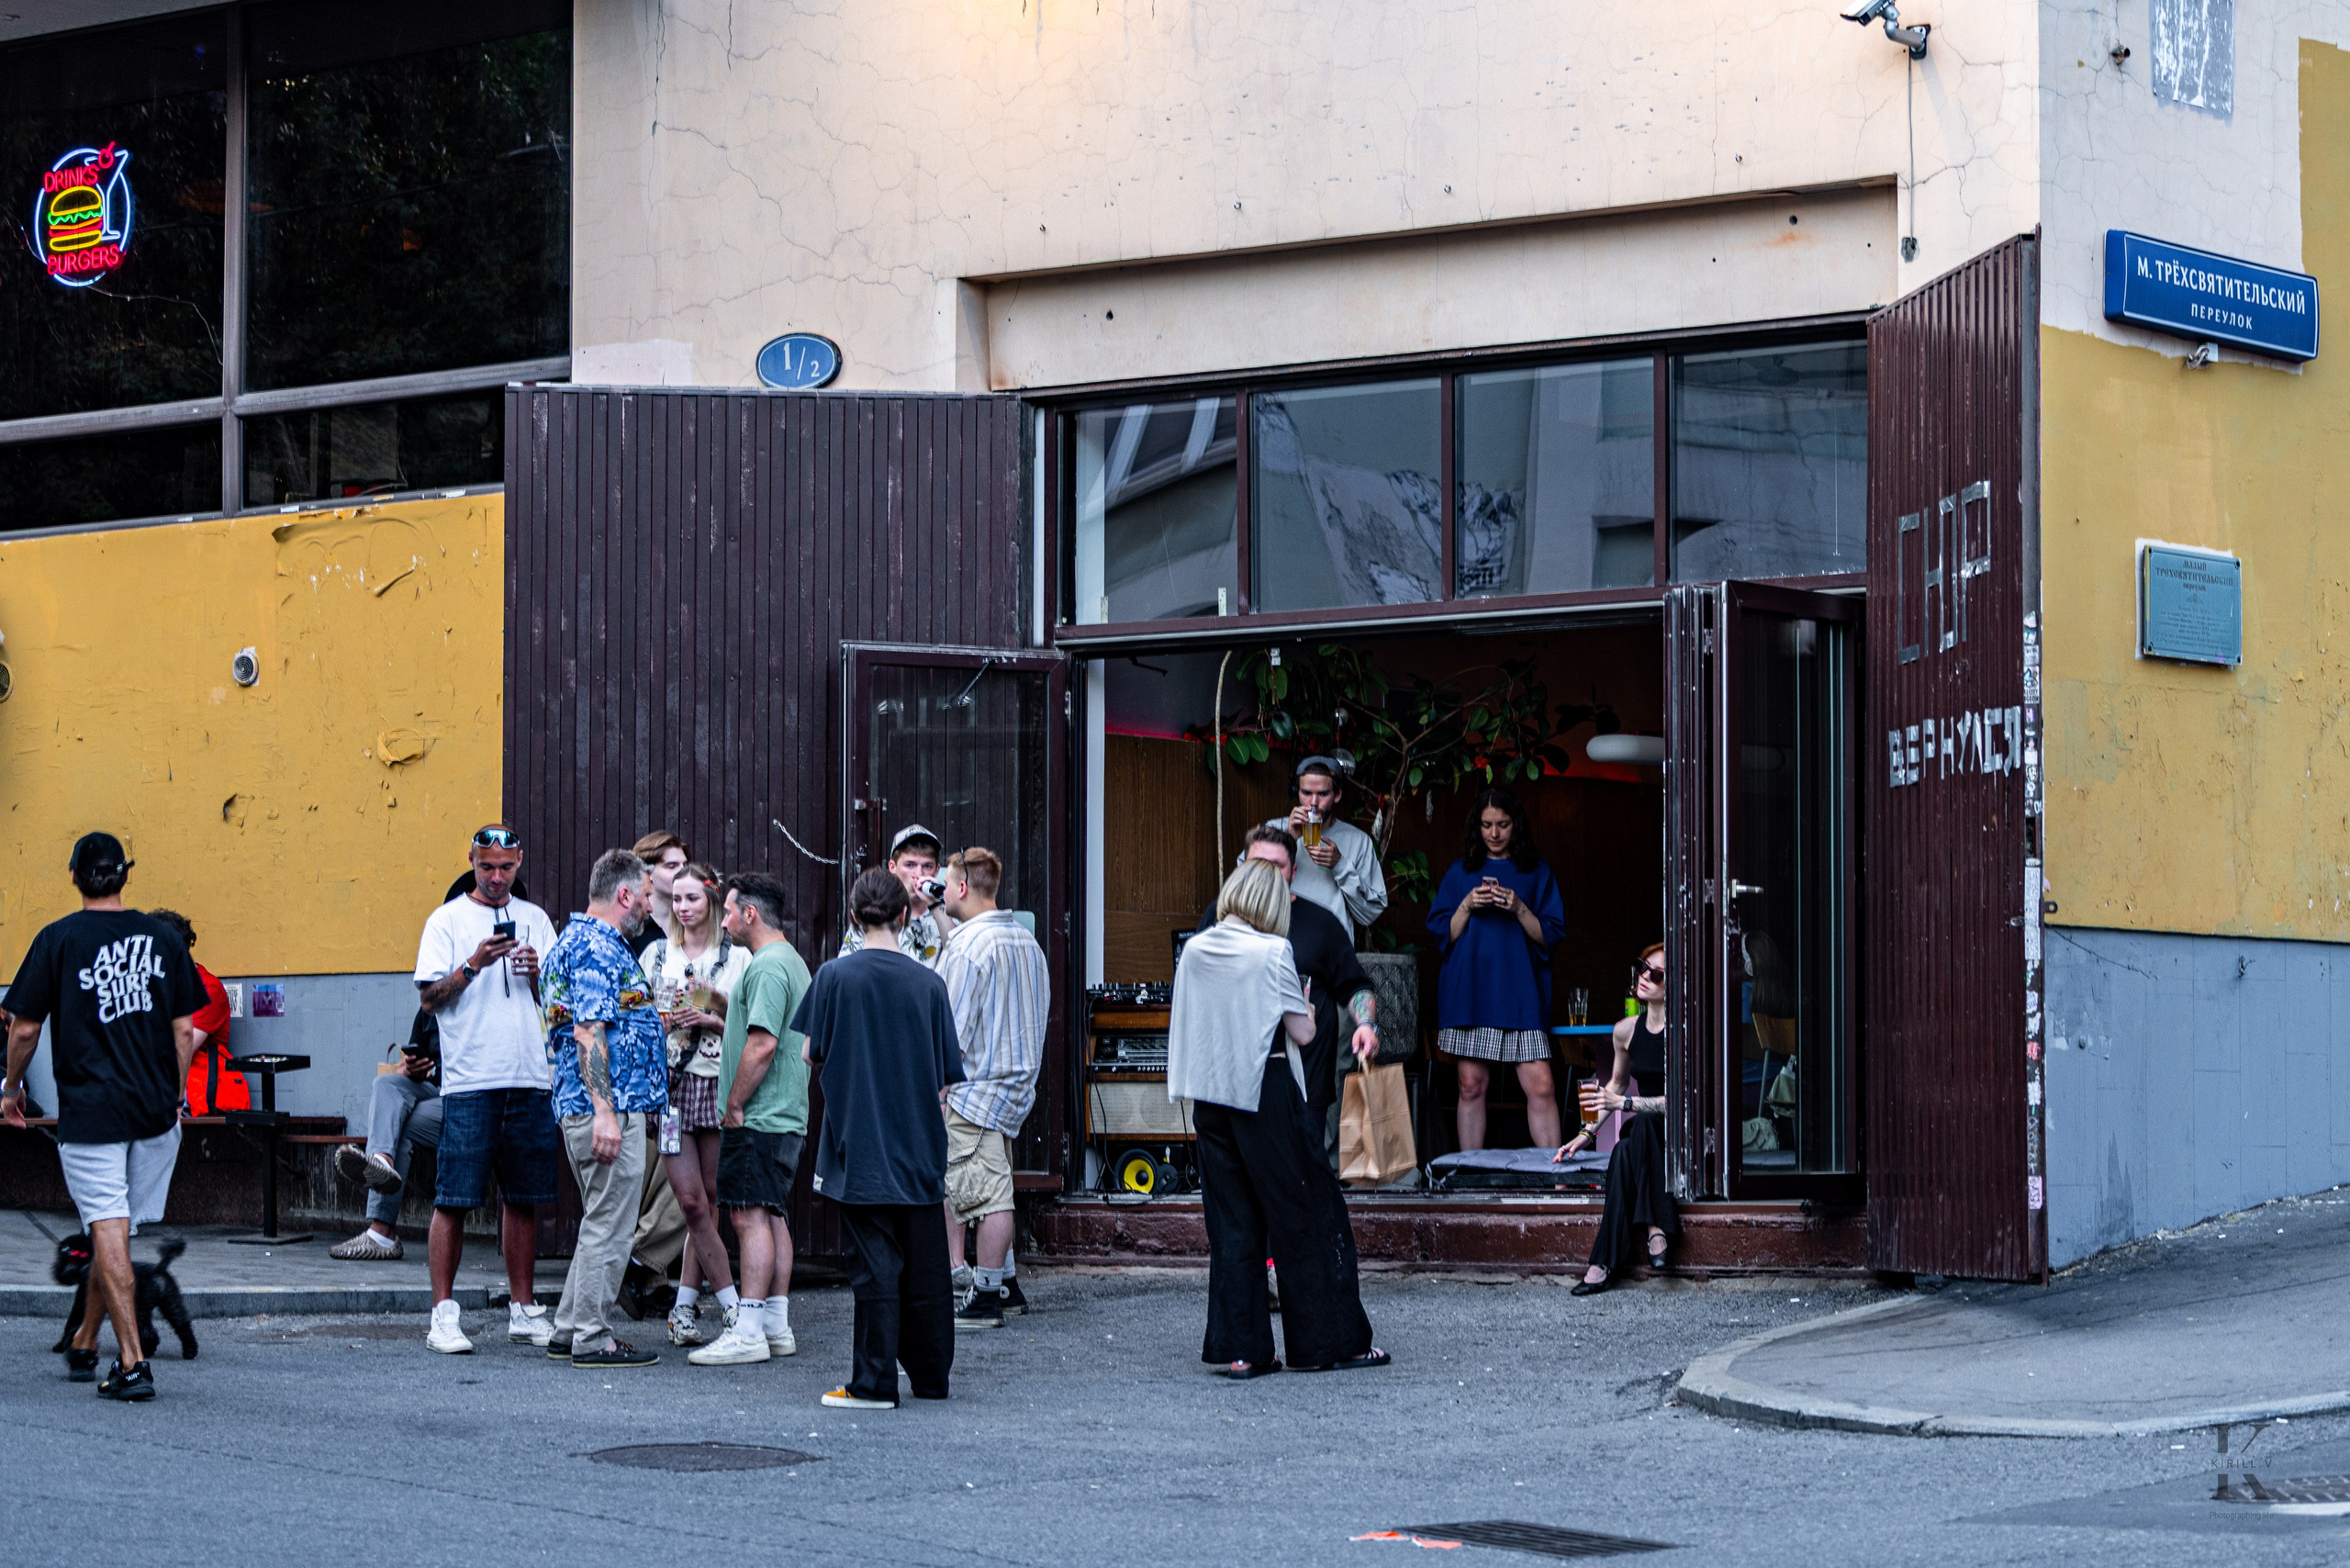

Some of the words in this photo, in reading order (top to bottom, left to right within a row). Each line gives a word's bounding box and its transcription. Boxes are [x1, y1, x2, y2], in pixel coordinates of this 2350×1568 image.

[44, 163, 99, 192] DRINKS
[47, 243, 120, 275] BURGERS
[2137, 255, 2153, 279] М.
[2155, 259, 2306, 315] ТРЁХСВЯТИТЕЛЬСКИЙ
[2190, 302, 2253, 330] ПЕРЕУЛОК
[1888, 705, 2021, 788] ВЕРНУЛСЯ
[94, 935, 153, 969] ANTI
[79, 952, 166, 990] SOCIAL
[97, 972, 151, 1005] SURF
[98, 991, 153, 1024] CLUB
